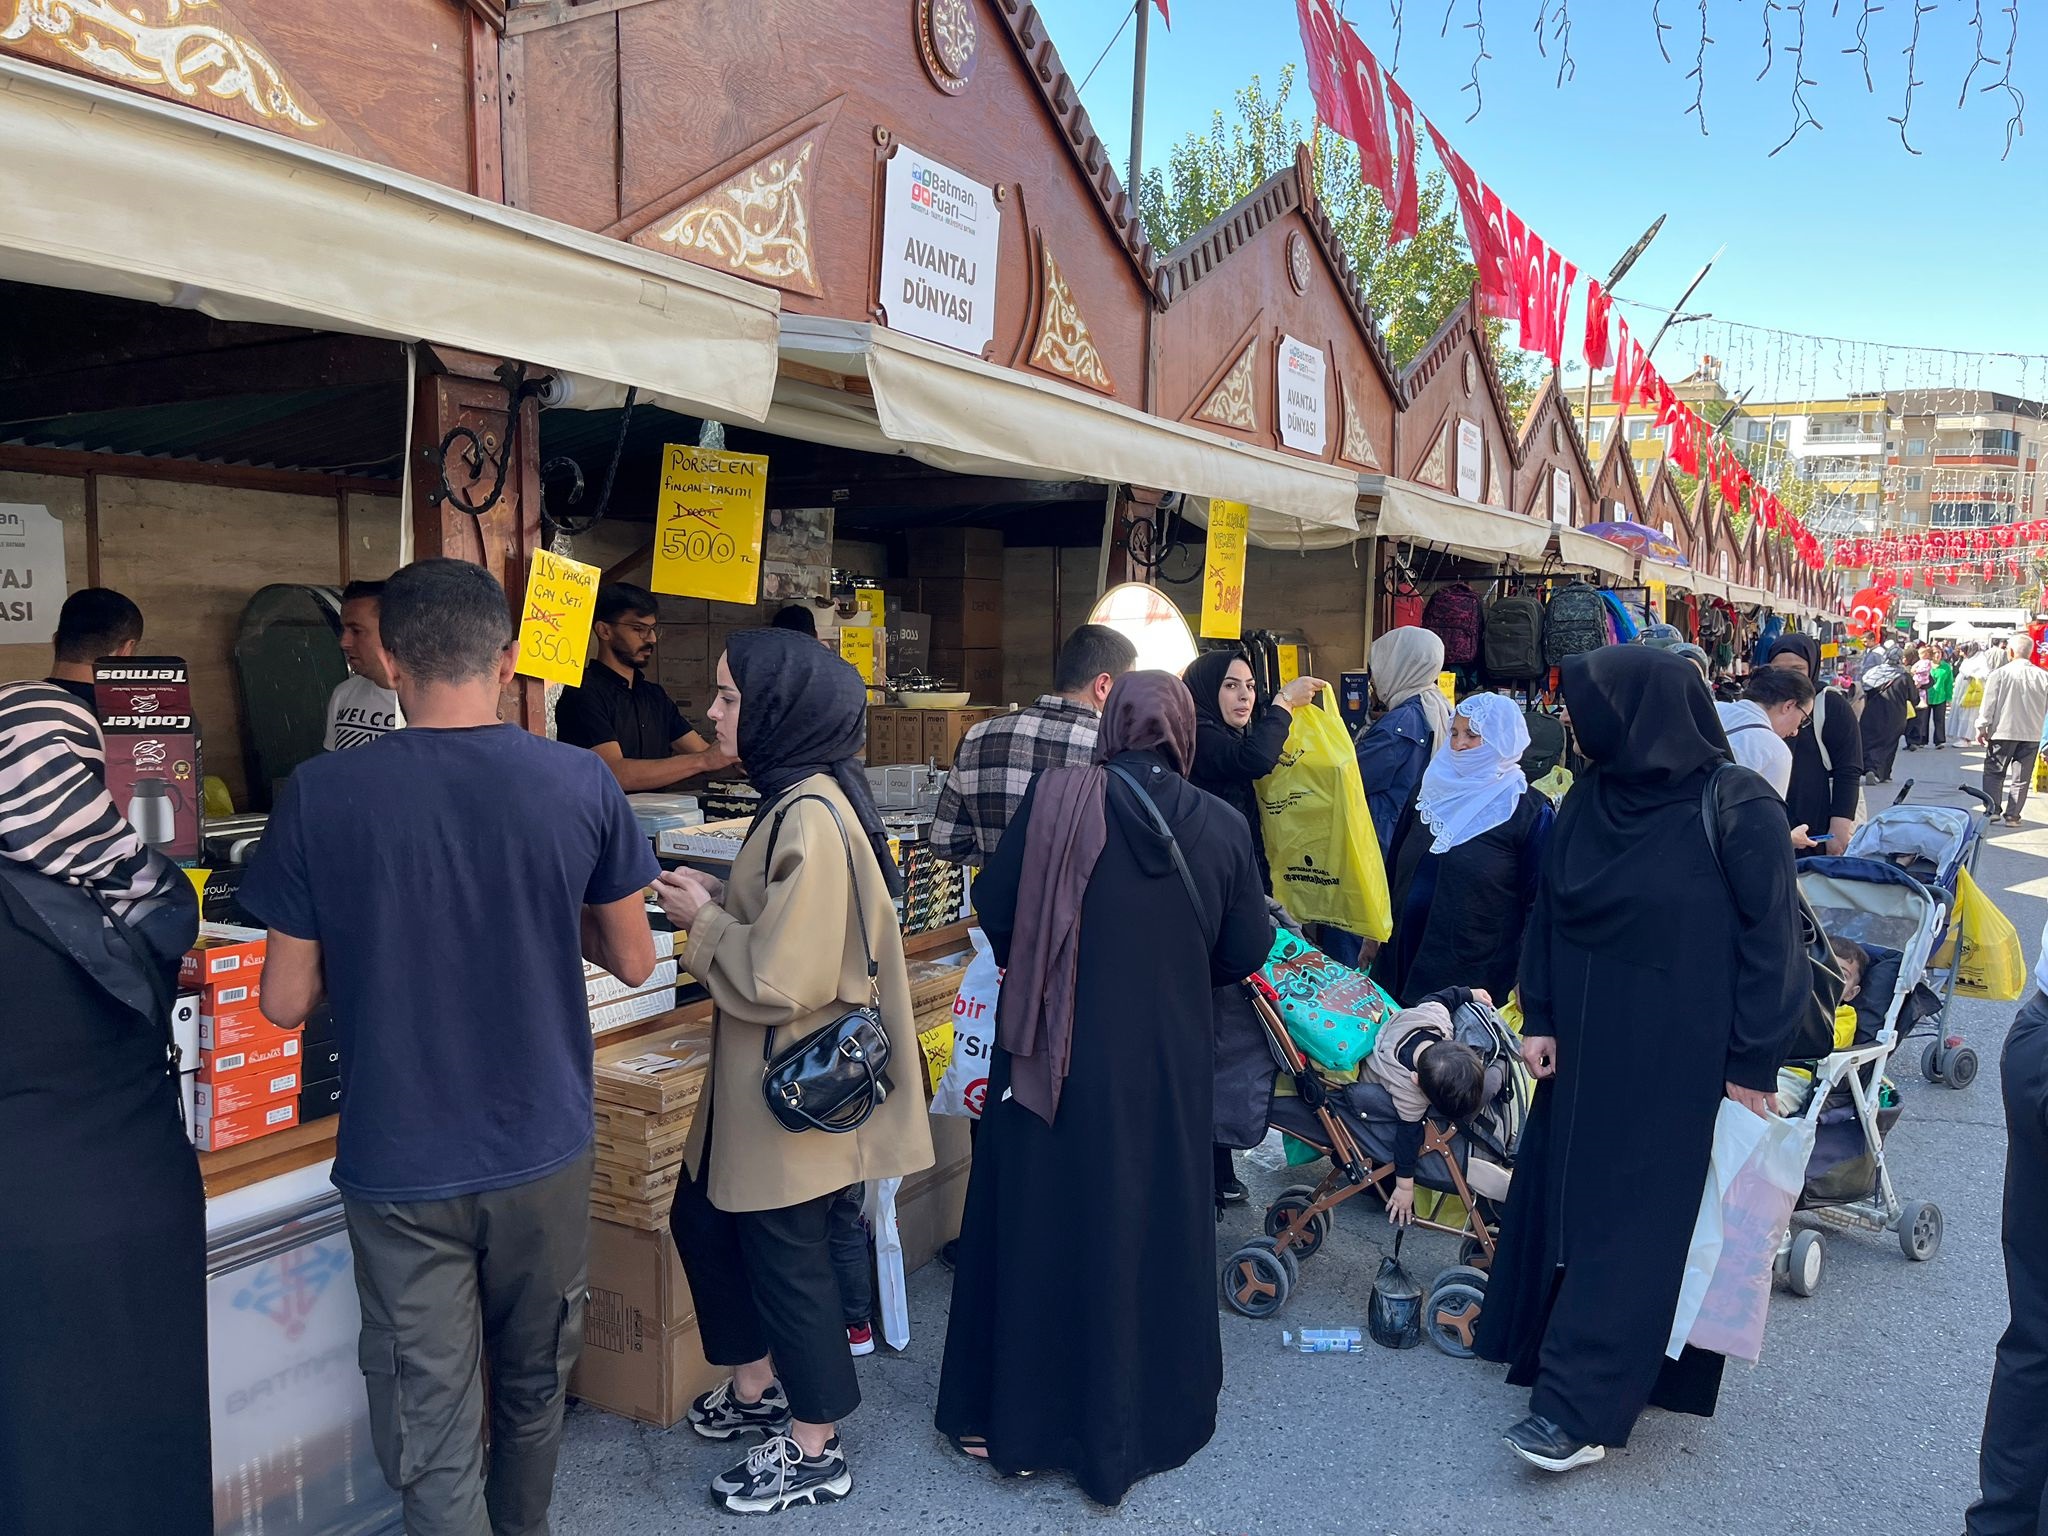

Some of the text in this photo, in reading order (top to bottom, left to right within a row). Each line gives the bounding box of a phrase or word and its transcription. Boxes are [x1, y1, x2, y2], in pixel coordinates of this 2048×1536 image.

[932, 173, 974, 207] Batman
[904, 237, 977, 286] AVANTAJ
[903, 277, 972, 324] DÜNYASI
[1287, 389, 1317, 414] AVANTAJ
[1287, 412, 1316, 438] DÜNYASI
[671, 450, 754, 477] PORSELEN
[662, 528, 754, 564] 500 TL
[536, 555, 555, 581] 18
[96, 670, 187, 682] Termos
[102, 716, 191, 728] Cooker
[953, 993, 987, 1019] bir
